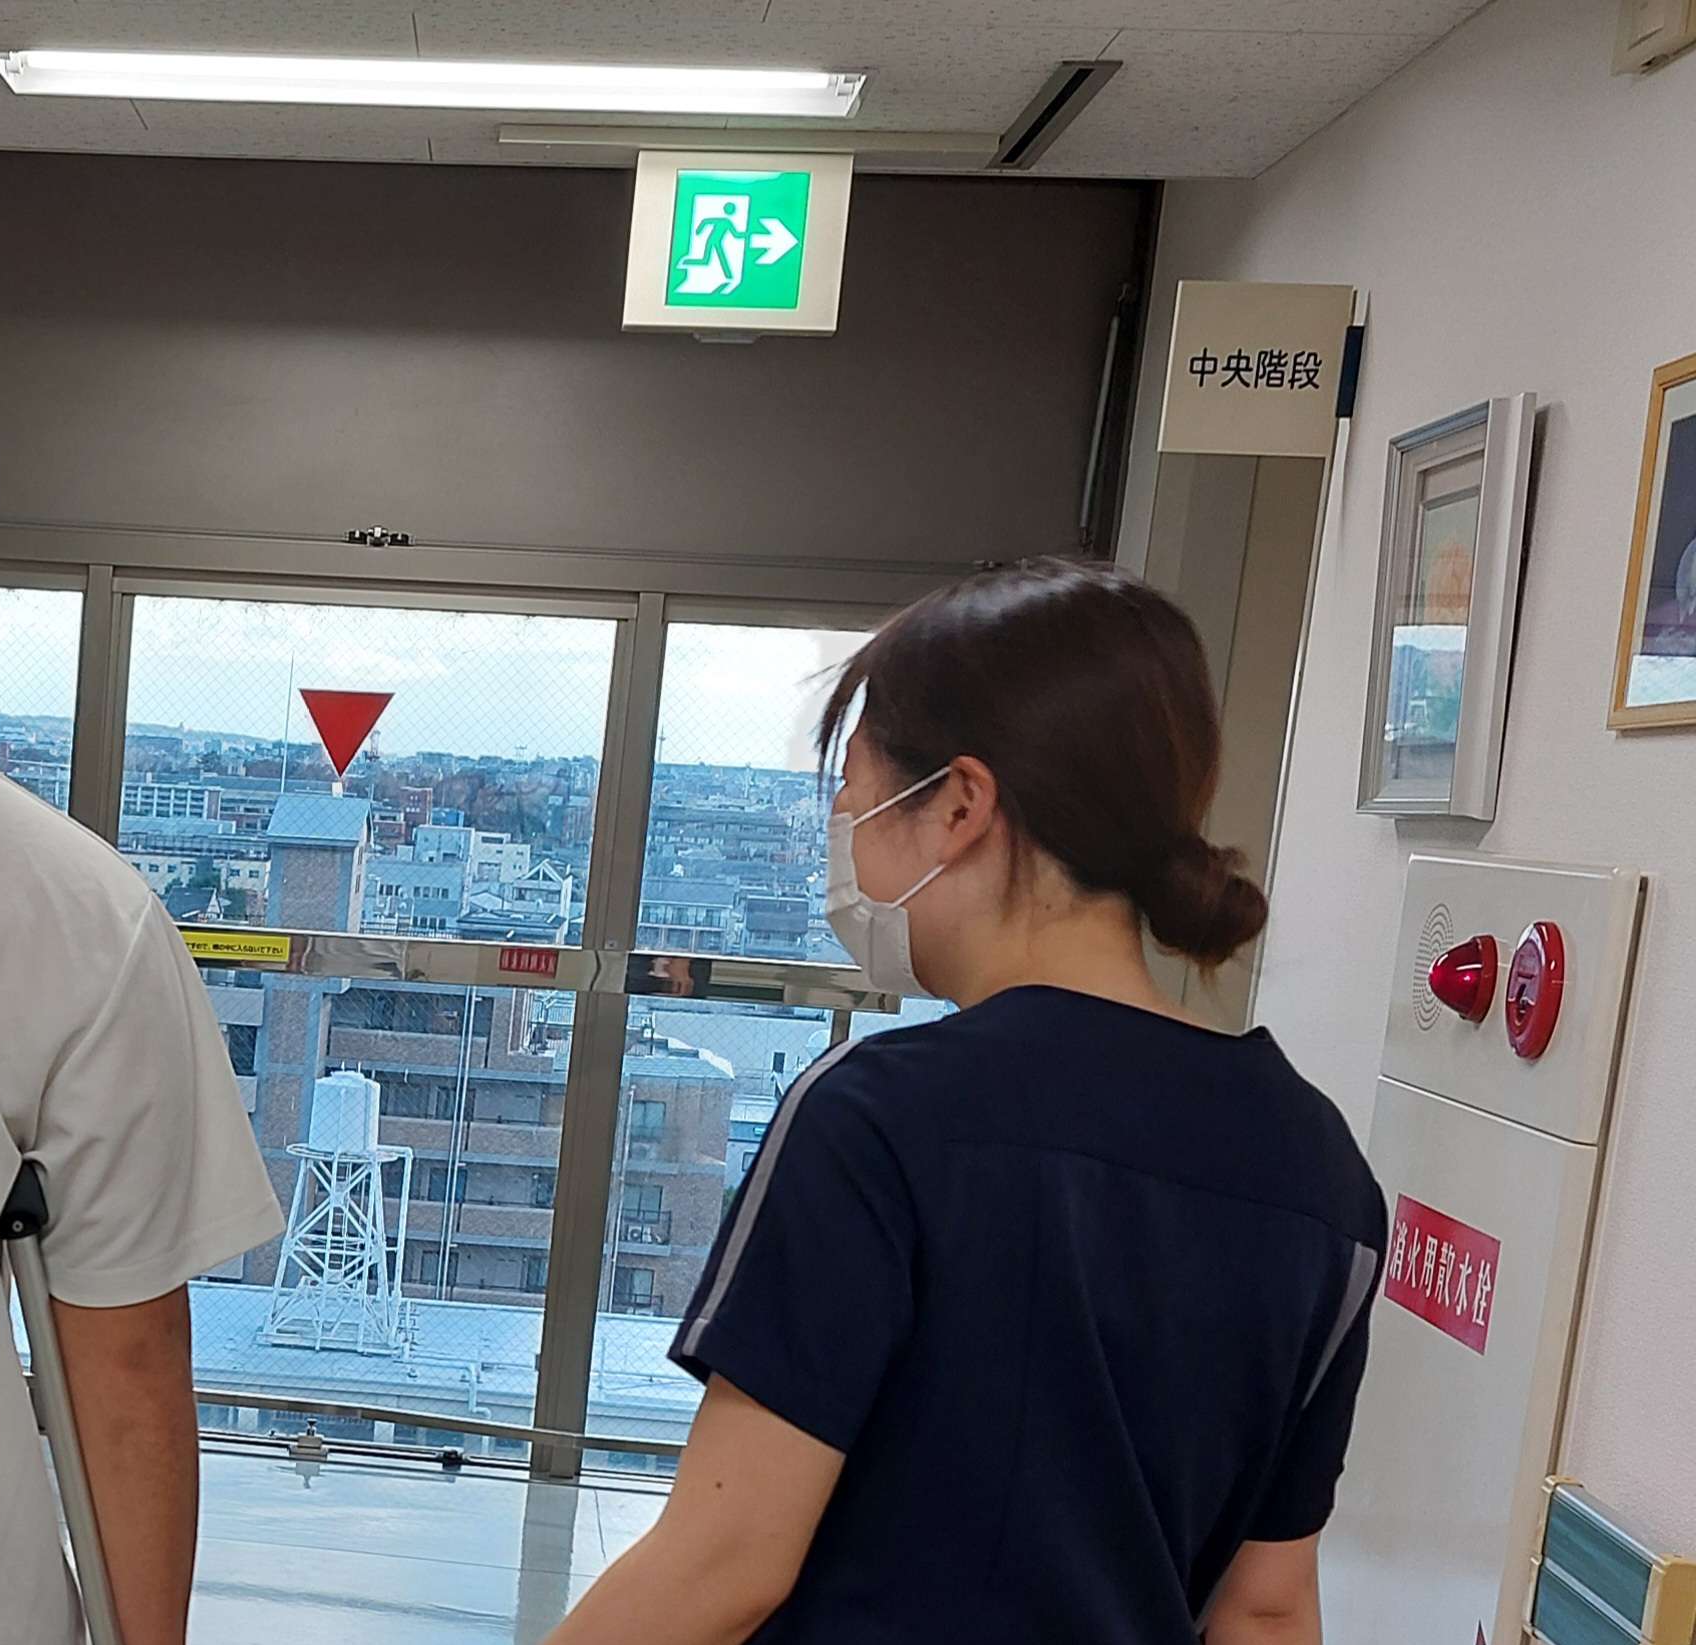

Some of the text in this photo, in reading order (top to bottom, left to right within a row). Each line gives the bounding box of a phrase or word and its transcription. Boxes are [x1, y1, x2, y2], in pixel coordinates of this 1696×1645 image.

[1189, 347, 1322, 390] 中央階段
[1389, 1219, 1493, 1327] 消火用散水栓
